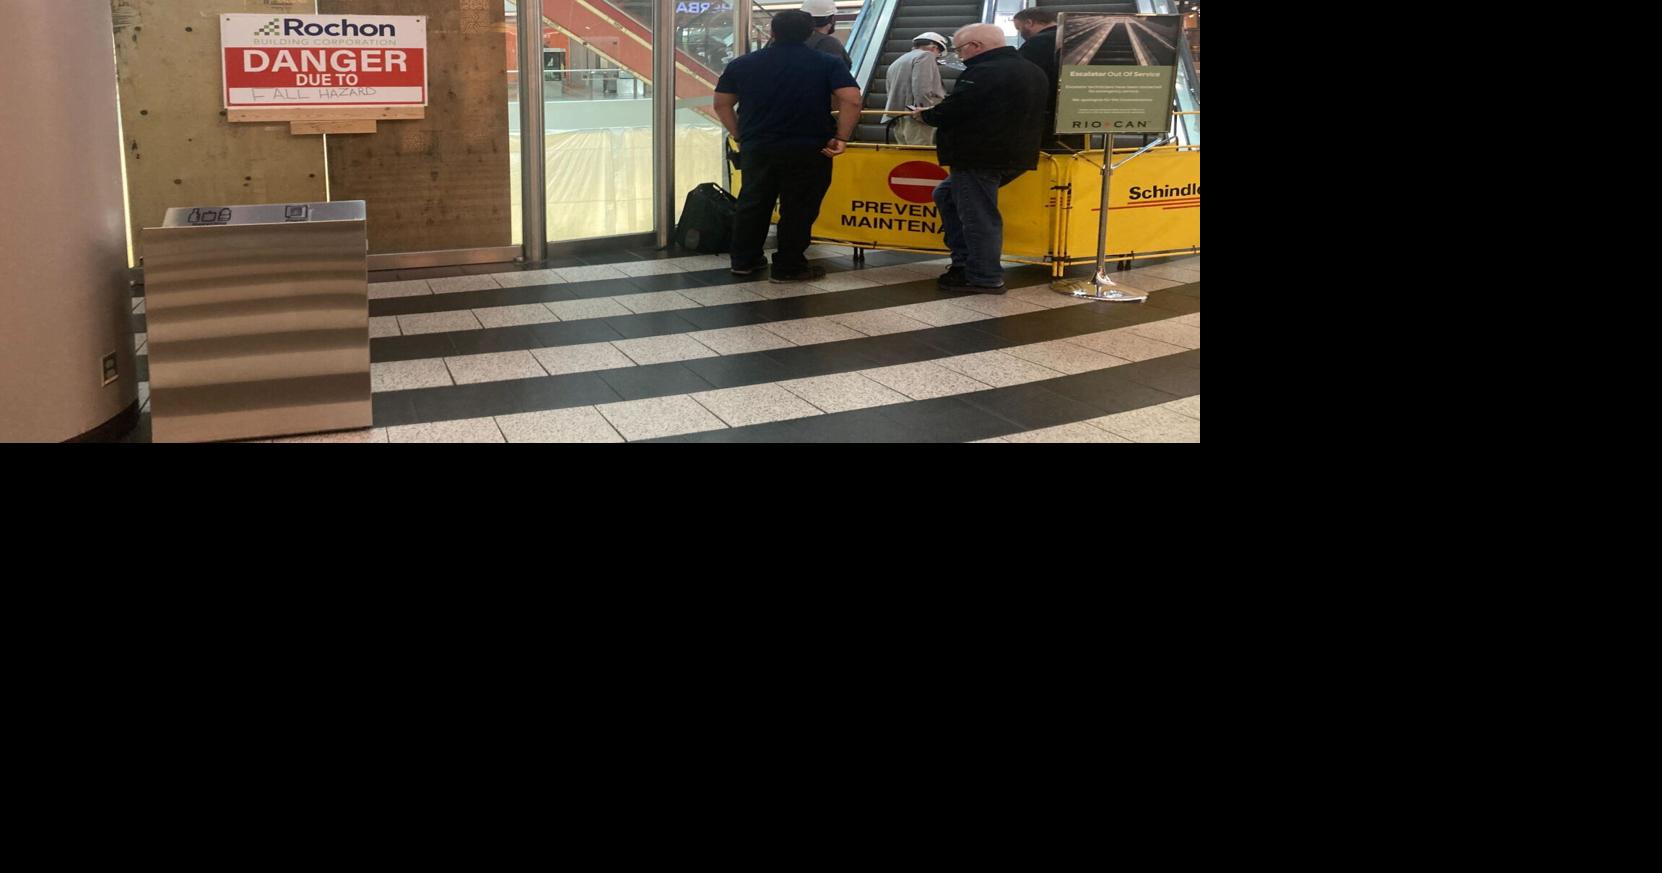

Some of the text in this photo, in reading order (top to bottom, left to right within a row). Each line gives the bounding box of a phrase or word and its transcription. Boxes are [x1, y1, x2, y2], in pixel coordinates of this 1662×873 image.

[284, 18, 396, 37] Rochon
[253, 38, 397, 46] BUILDING CORPORATION
[243, 49, 407, 73] DANGER
[296, 73, 358, 86] DUE TO
[319, 87, 377, 100] HAZARD
[1129, 183, 1200, 200] Schindl
[851, 200, 937, 218] PREVEN
